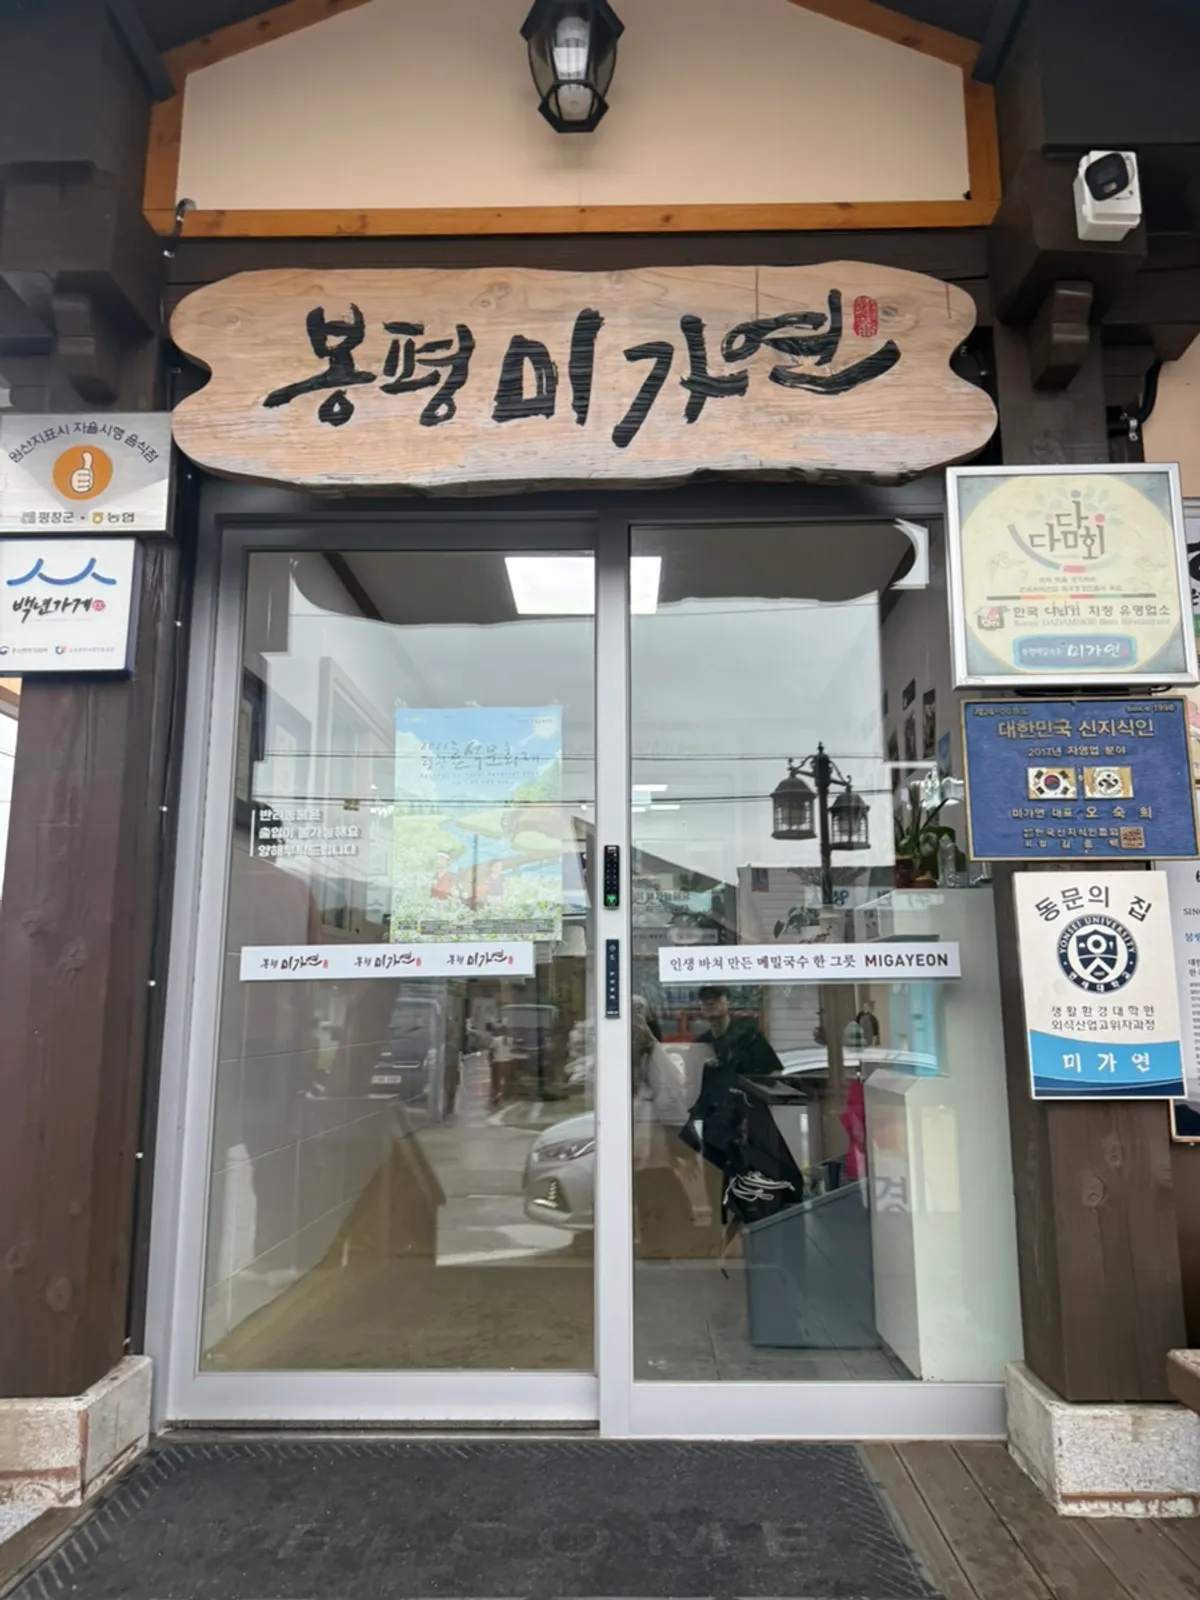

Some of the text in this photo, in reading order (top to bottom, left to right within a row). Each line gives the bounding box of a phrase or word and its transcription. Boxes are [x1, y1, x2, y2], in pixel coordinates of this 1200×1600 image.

[263, 288, 901, 448] 봉평 미가연
[8, 424, 70, 464] 원산지표시
[124, 434, 160, 464] 음식점
[38, 511, 74, 524] 평창군
[107, 512, 135, 523] 농협
[12, 596, 93, 624] 백년가게
[1013, 606, 1039, 618] 한국
[1088, 605, 1113, 617] 지정
[1120, 604, 1171, 616] 유명업소
[1067, 643, 1122, 658] 미가연
[998, 719, 1155, 738] 대한민국 신지식인
[1034, 885, 1152, 922] 동문의 집
[1059, 915, 1137, 954] YONSEI UNIVERSITY
[280, 953, 323, 971] 미가연
[374, 951, 416, 969] 미가연
[466, 949, 508, 967] 미가연
[670, 953, 948, 971] 인생 바쳐 만든 메밀국수 한 그릇 MIGAYEON
[1051, 1020, 1155, 1032] 외식산업고위자과정
